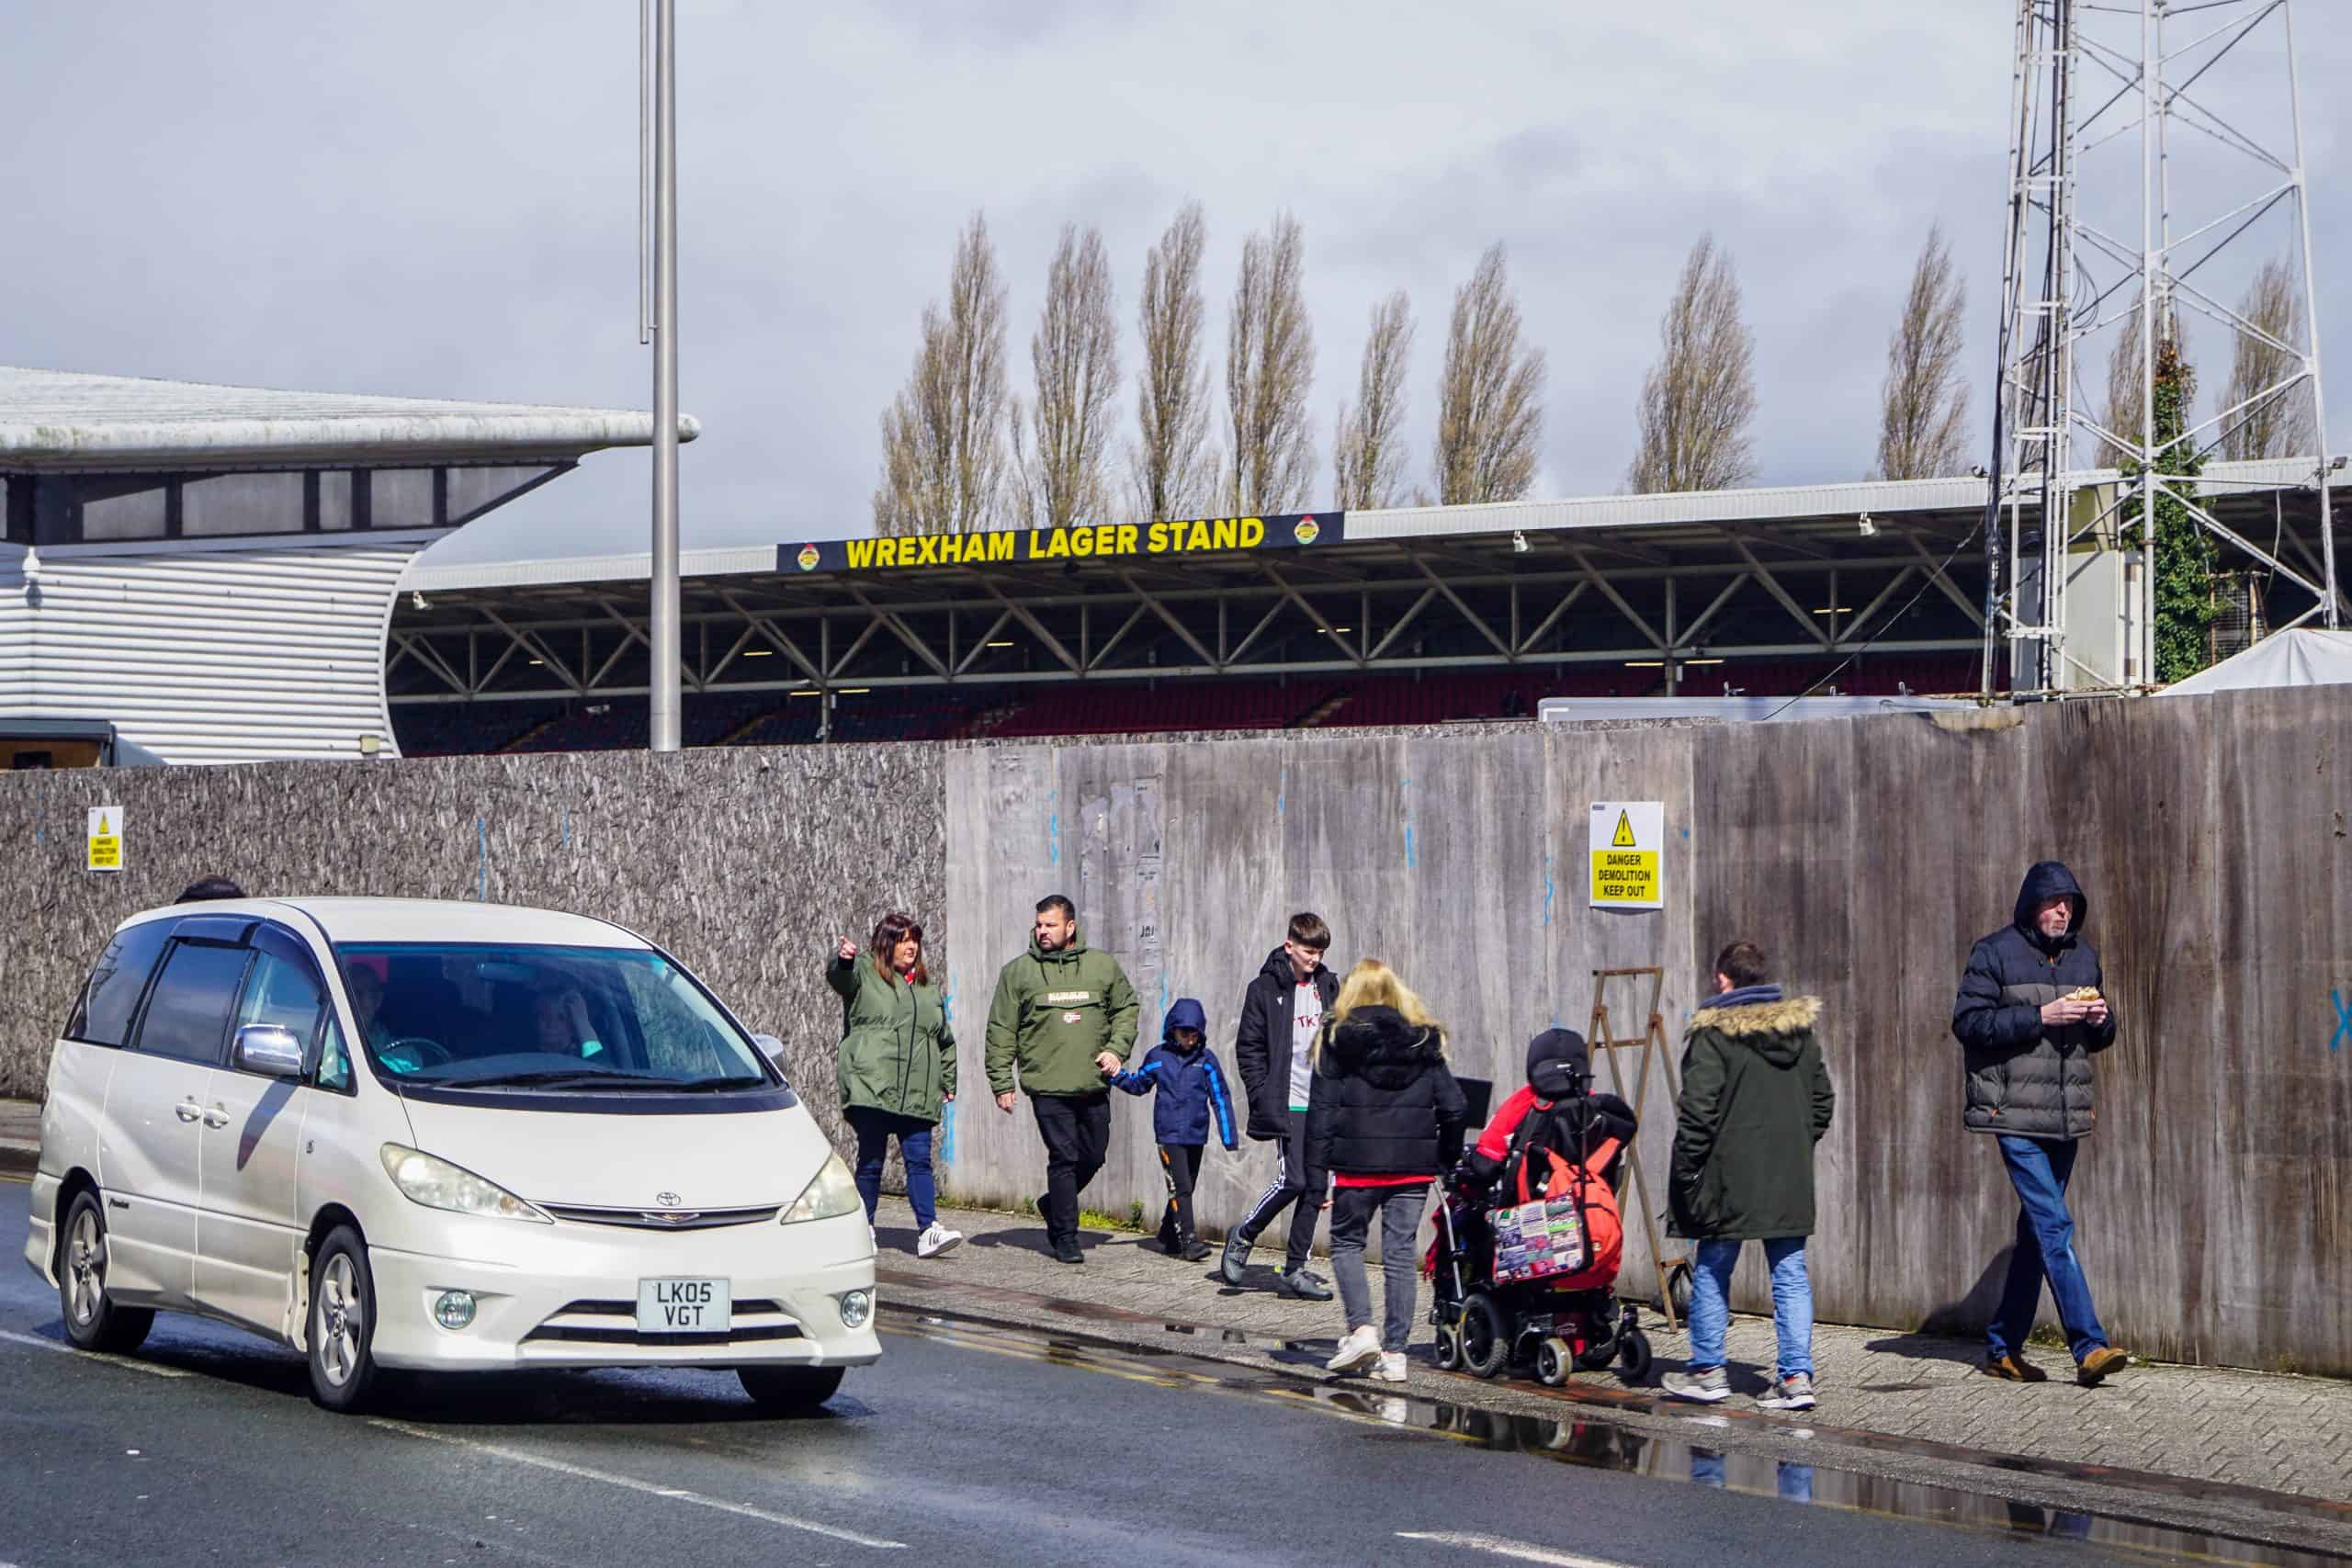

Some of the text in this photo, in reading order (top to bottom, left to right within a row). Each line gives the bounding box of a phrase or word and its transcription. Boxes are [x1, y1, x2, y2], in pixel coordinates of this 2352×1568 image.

[845, 517, 1265, 569] WREXHAM LAGER STAND
[1606, 854, 1642, 865] DANGER
[1598, 869, 1651, 881] DEMOLITION
[1603, 885, 1645, 897] KEEP OUT
[657, 1282, 712, 1303] LK05
[664, 1305, 704, 1325] VGT
